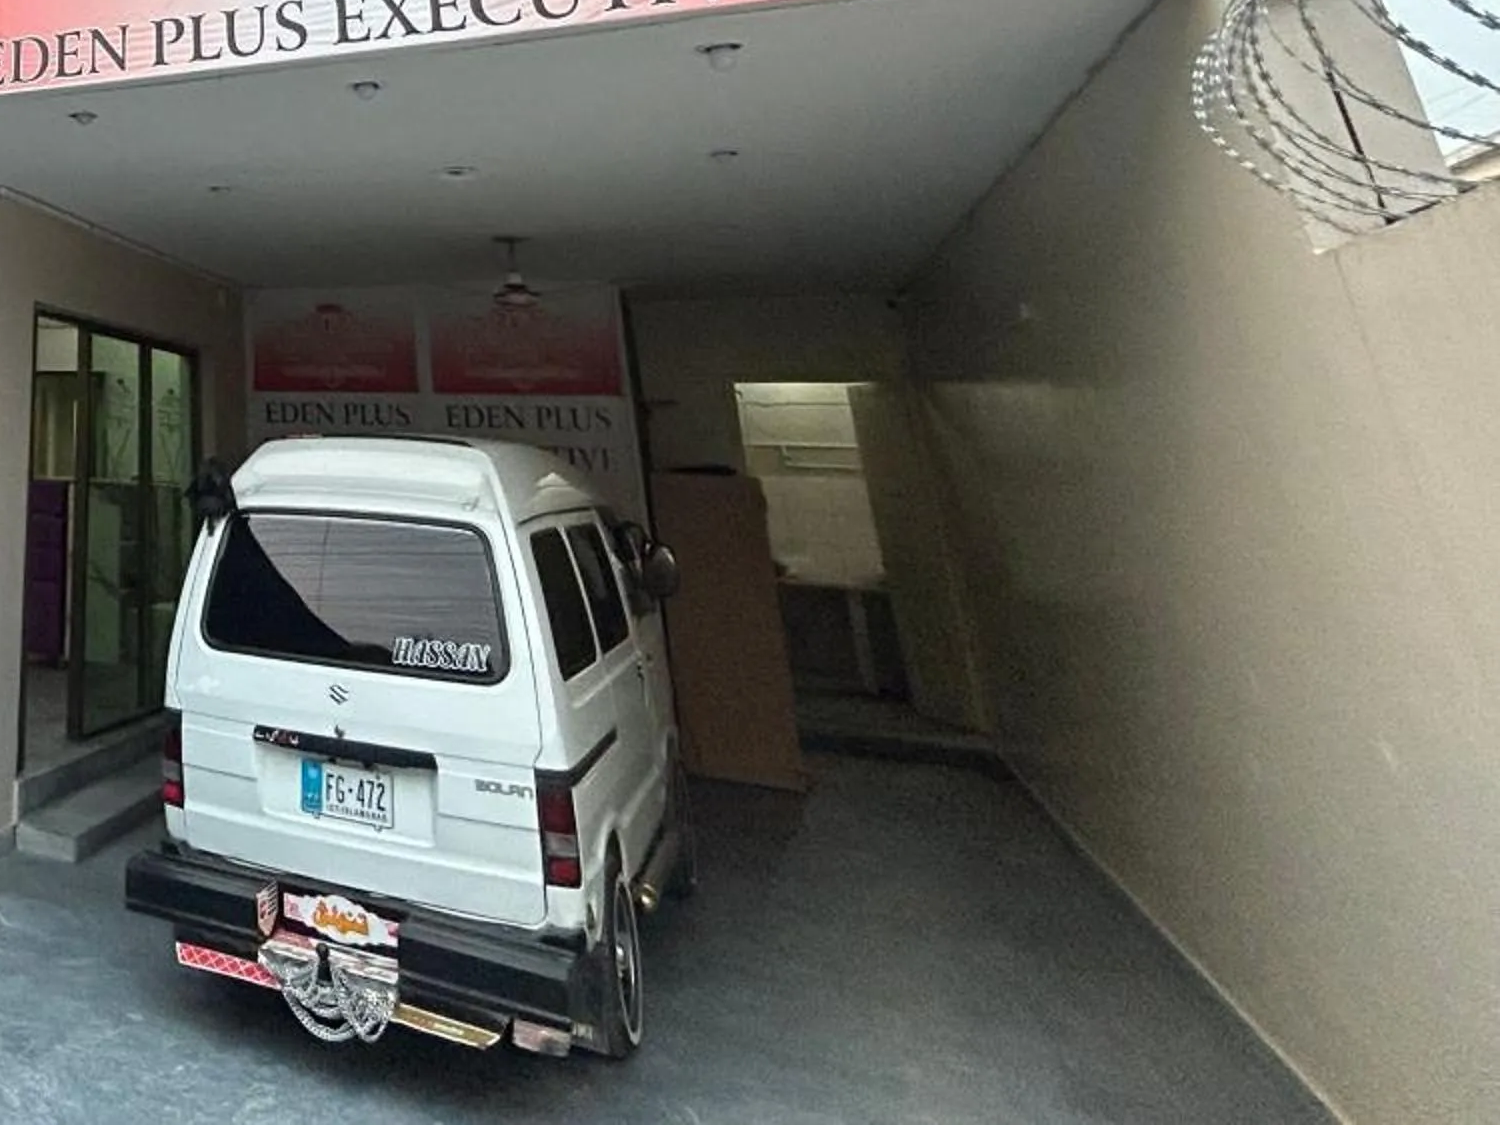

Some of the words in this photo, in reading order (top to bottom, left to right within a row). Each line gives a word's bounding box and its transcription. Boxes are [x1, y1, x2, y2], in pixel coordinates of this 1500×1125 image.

[152, 0, 309, 67] PLUS
[265, 400, 335, 426] EDEN
[344, 402, 412, 429] PLUS
[446, 404, 526, 431] EDEN
[536, 404, 613, 432] PLUS
[392, 636, 491, 673] HASSAN
